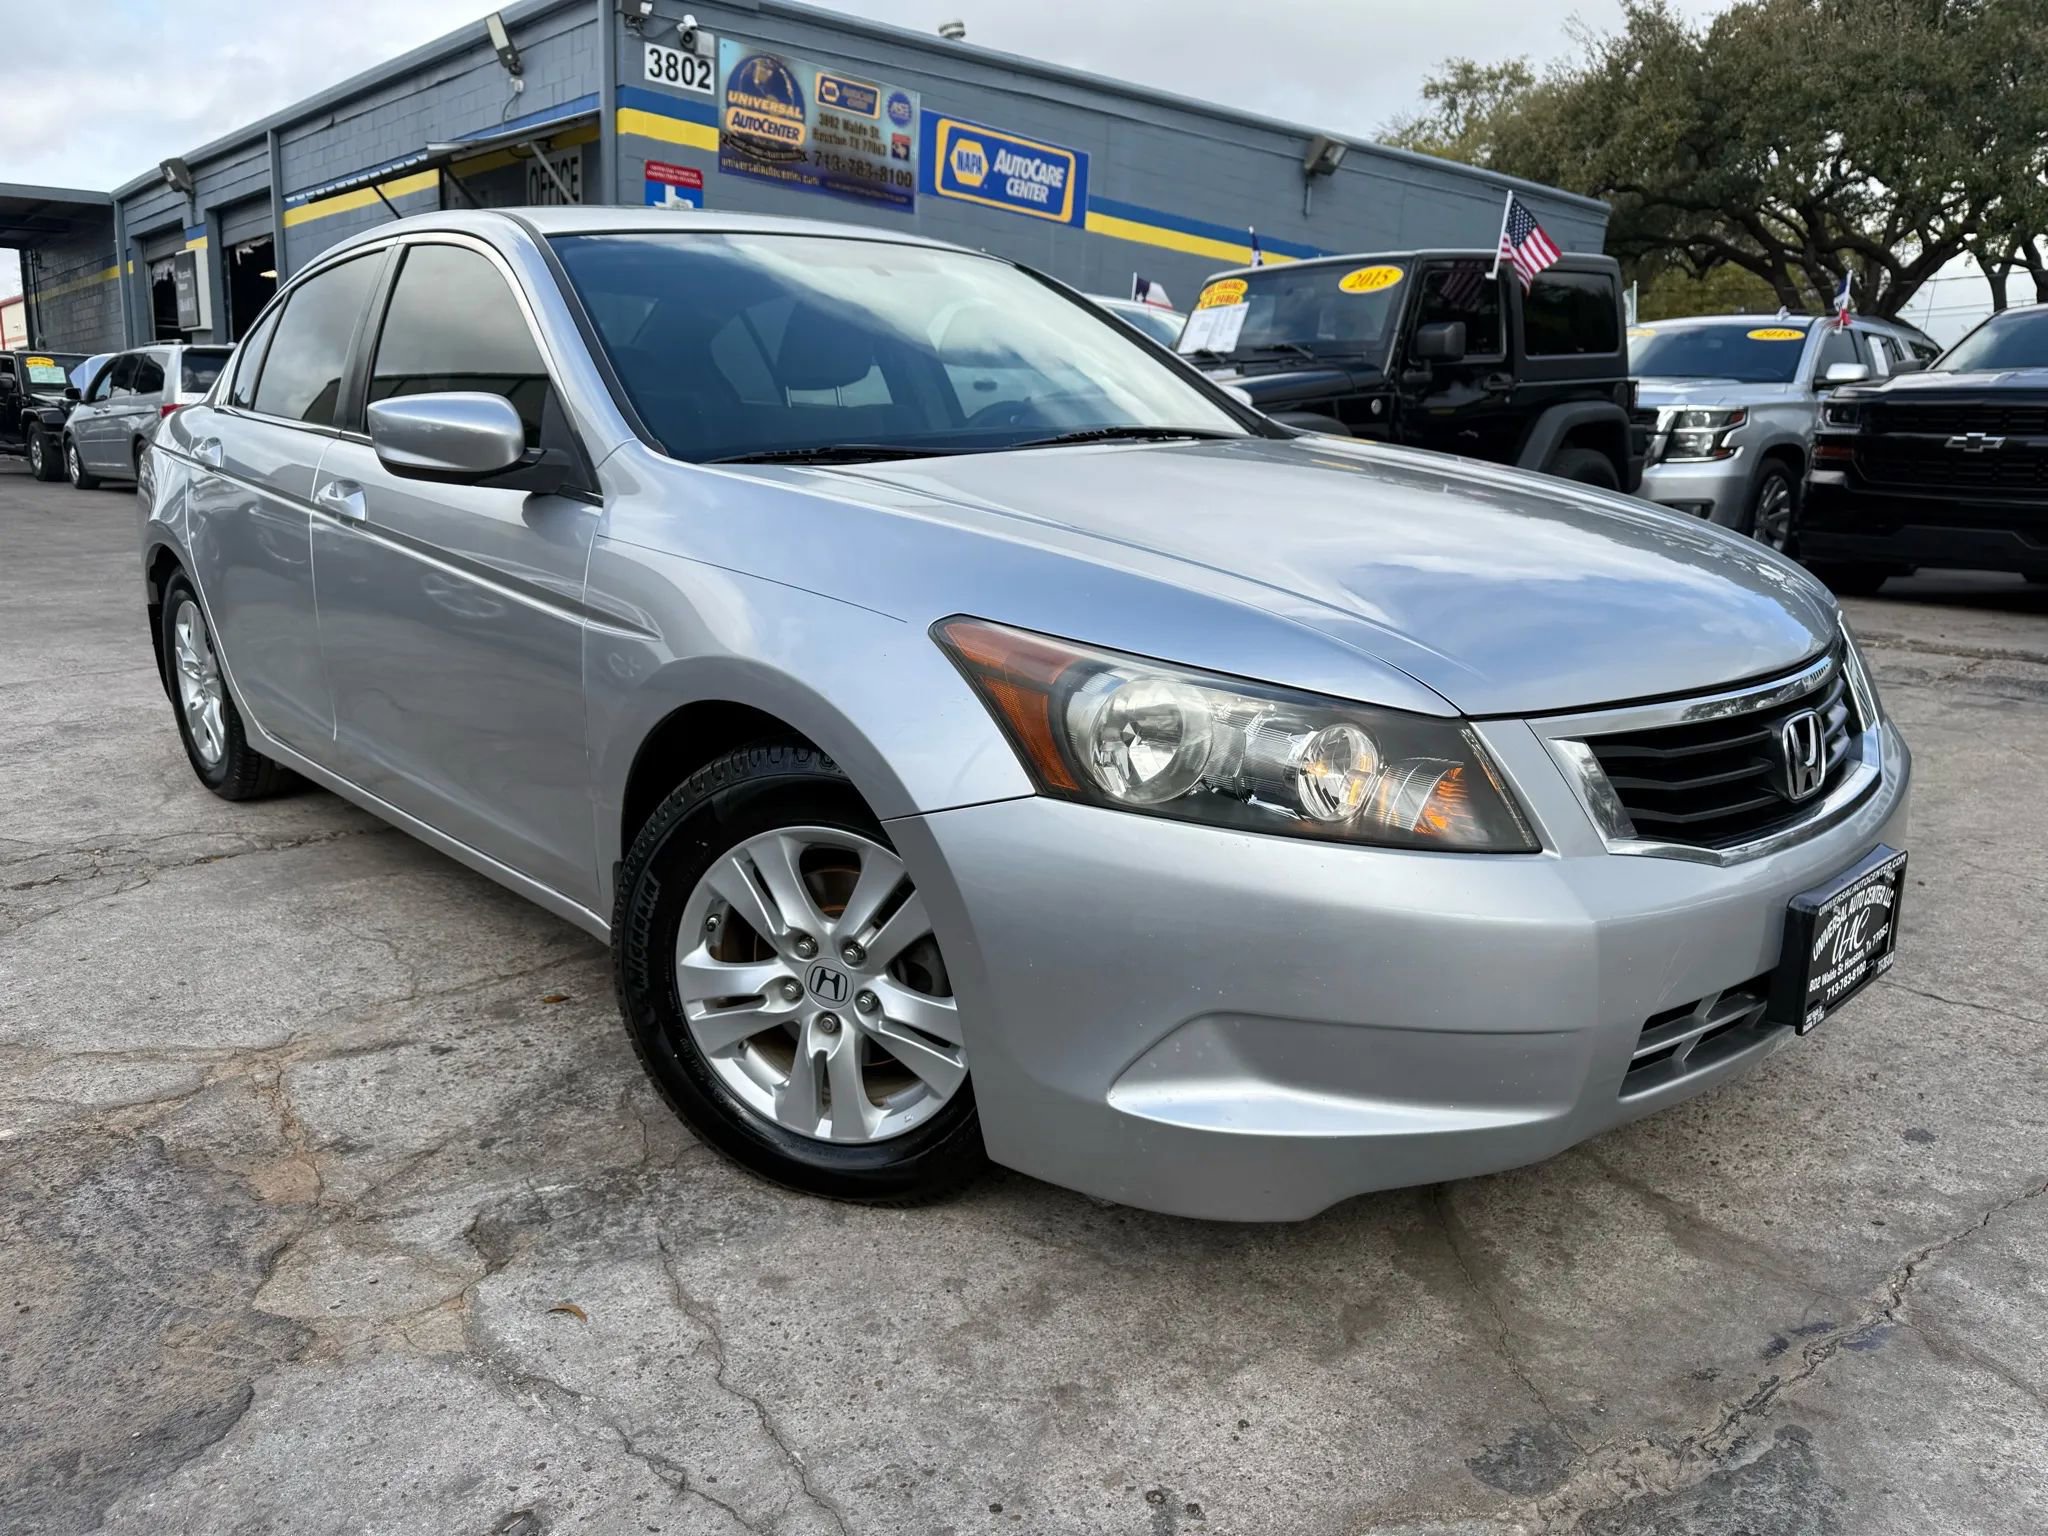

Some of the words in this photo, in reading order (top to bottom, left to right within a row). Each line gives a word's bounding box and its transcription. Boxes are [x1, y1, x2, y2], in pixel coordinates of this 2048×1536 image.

[648, 48, 711, 90] 3802
[728, 90, 803, 119] UNIVERSAL
[732, 111, 800, 140] AUTOCENTER
[957, 150, 983, 176] NAPA
[993, 148, 1065, 188] AUTOCARE
[529, 156, 579, 205] OFFICE
[1006, 178, 1049, 204] CENTER
[1348, 268, 1394, 289] 2015
[1813, 902, 1848, 961] UNIVERSAL
[1847, 889, 1865, 916] AUTO
[1864, 885, 1886, 906] CENTER
[1827, 960, 1867, 1000] 713-783-8100
